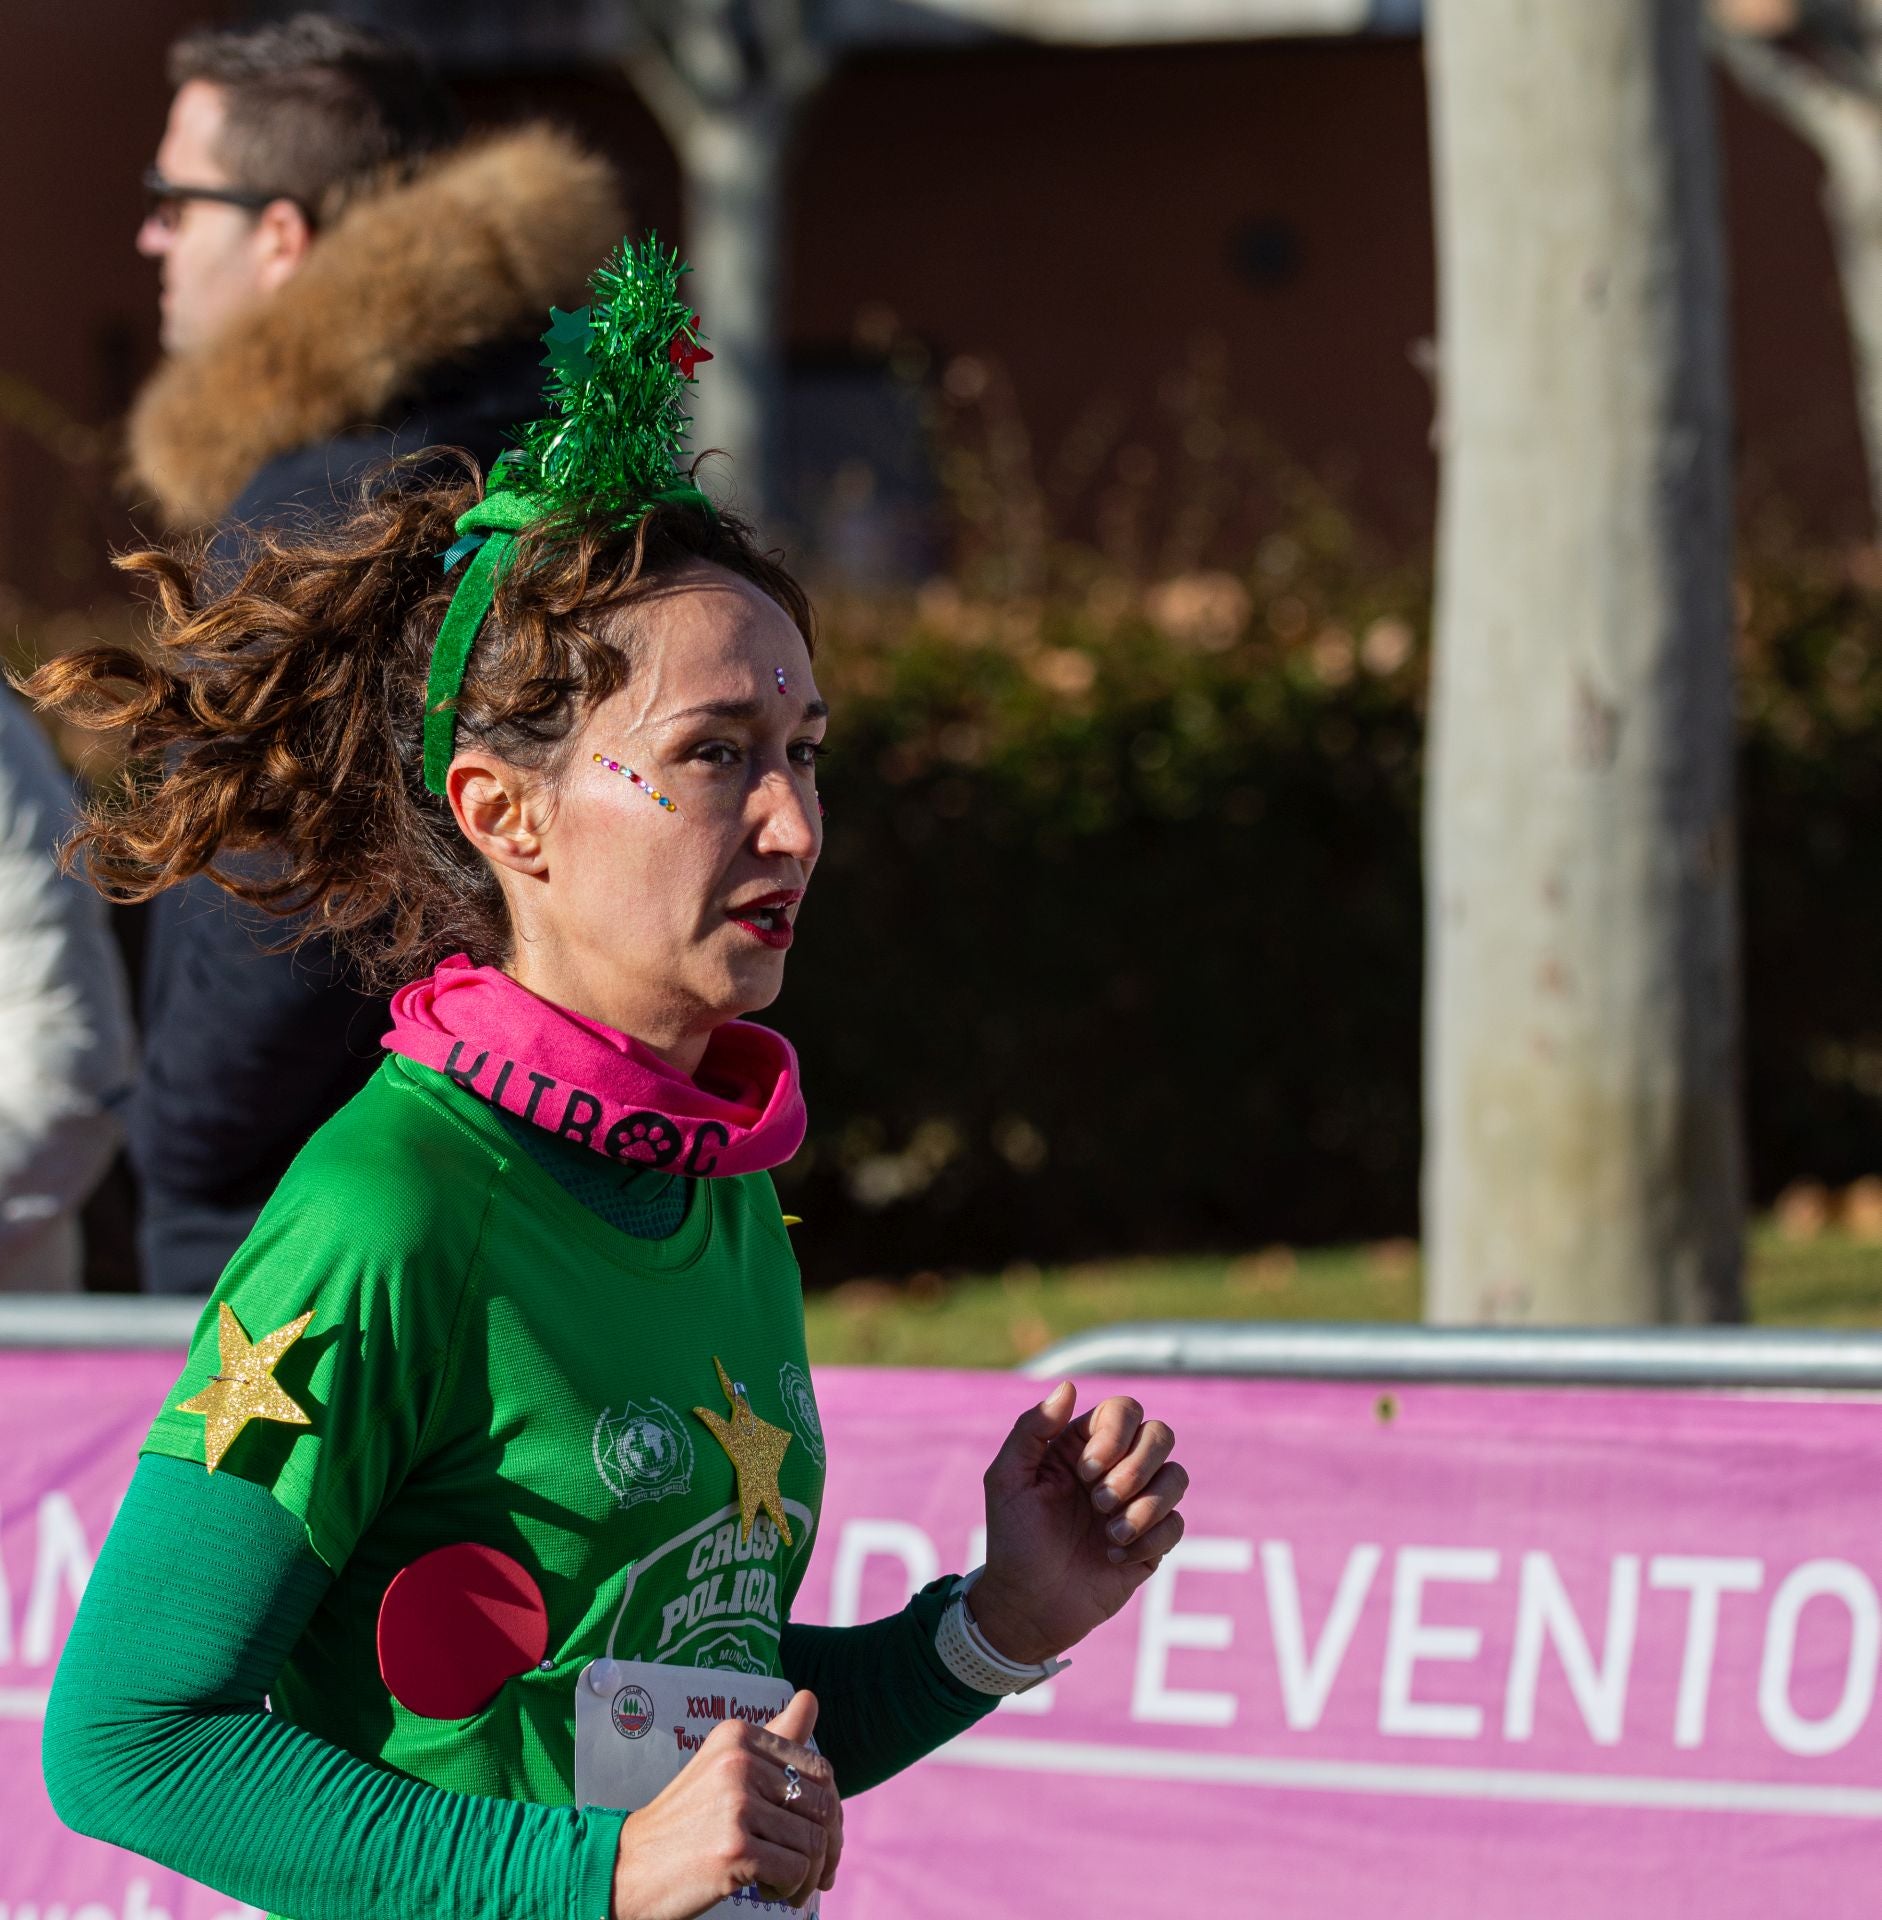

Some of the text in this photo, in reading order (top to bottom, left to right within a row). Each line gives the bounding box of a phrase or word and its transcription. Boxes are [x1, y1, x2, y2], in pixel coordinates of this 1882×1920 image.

[686, 1514, 780, 1581] CROSS
[656, 1568, 779, 1650] POLICIA
[1131, 1535, 1880, 1757] EVENTO
